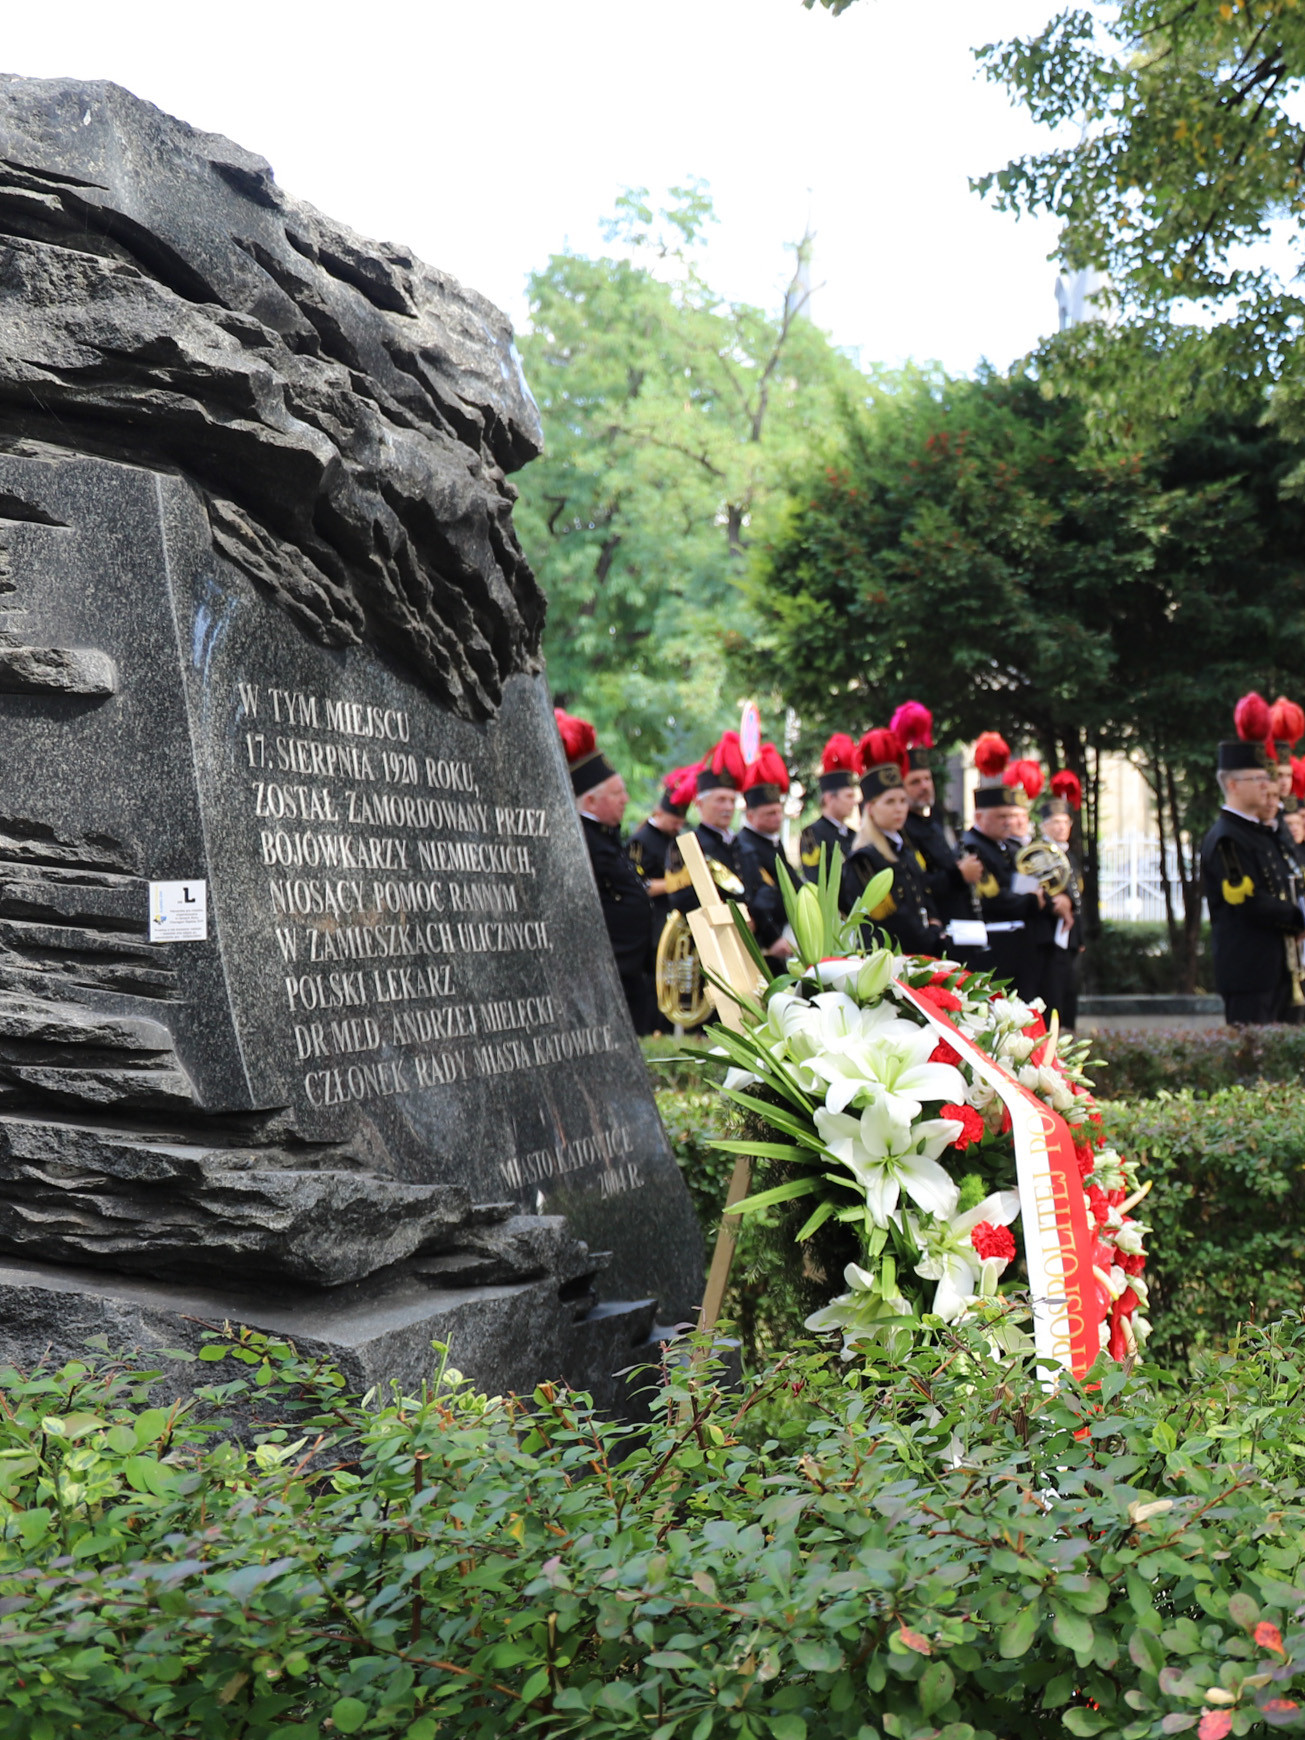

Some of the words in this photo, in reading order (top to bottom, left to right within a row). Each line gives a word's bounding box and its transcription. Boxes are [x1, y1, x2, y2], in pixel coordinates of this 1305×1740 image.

[239, 682, 259, 718] W
[268, 688, 319, 729] TYM
[325, 698, 410, 743] MIEJSCU
[245, 733, 273, 770] 17.
[276, 736, 375, 781] SIERPNIA
[381, 750, 418, 785] 1920
[425, 758, 479, 798] ROKU,
[252, 782, 338, 821] ZOSTAŁ
[345, 791, 488, 834] ZAMORDOWANY
[495, 807, 549, 838] PRZEZ
[260, 829, 408, 871] BOJÓWKARZY
[417, 840, 536, 878] NIEMIECKICH,
[269, 879, 365, 922] NIOSĄCY
[373, 881, 445, 913] POMOC
[449, 882, 518, 912] RANNYM
[276, 927, 297, 962] W
[306, 922, 455, 962] ZAMIESZKACH
[457, 920, 554, 953] ULICZNYCH,
[285, 973, 367, 1011] POLSKI
[374, 965, 456, 1002] LEKARZ
[294, 1021, 331, 1060] DR
[331, 1016, 386, 1054] MED.
[393, 1003, 478, 1046] ANDRZEJ
[304, 1060, 411, 1108] CZŁONEK
[415, 1050, 470, 1089] RADY
[473, 1038, 532, 1076] MIASTA
[534, 1025, 619, 1066] KATOWICE.
[500, 1149, 554, 1192] MIASTO
[555, 1127, 634, 1174] KATOWICE
[598, 1165, 627, 1200] 2004
